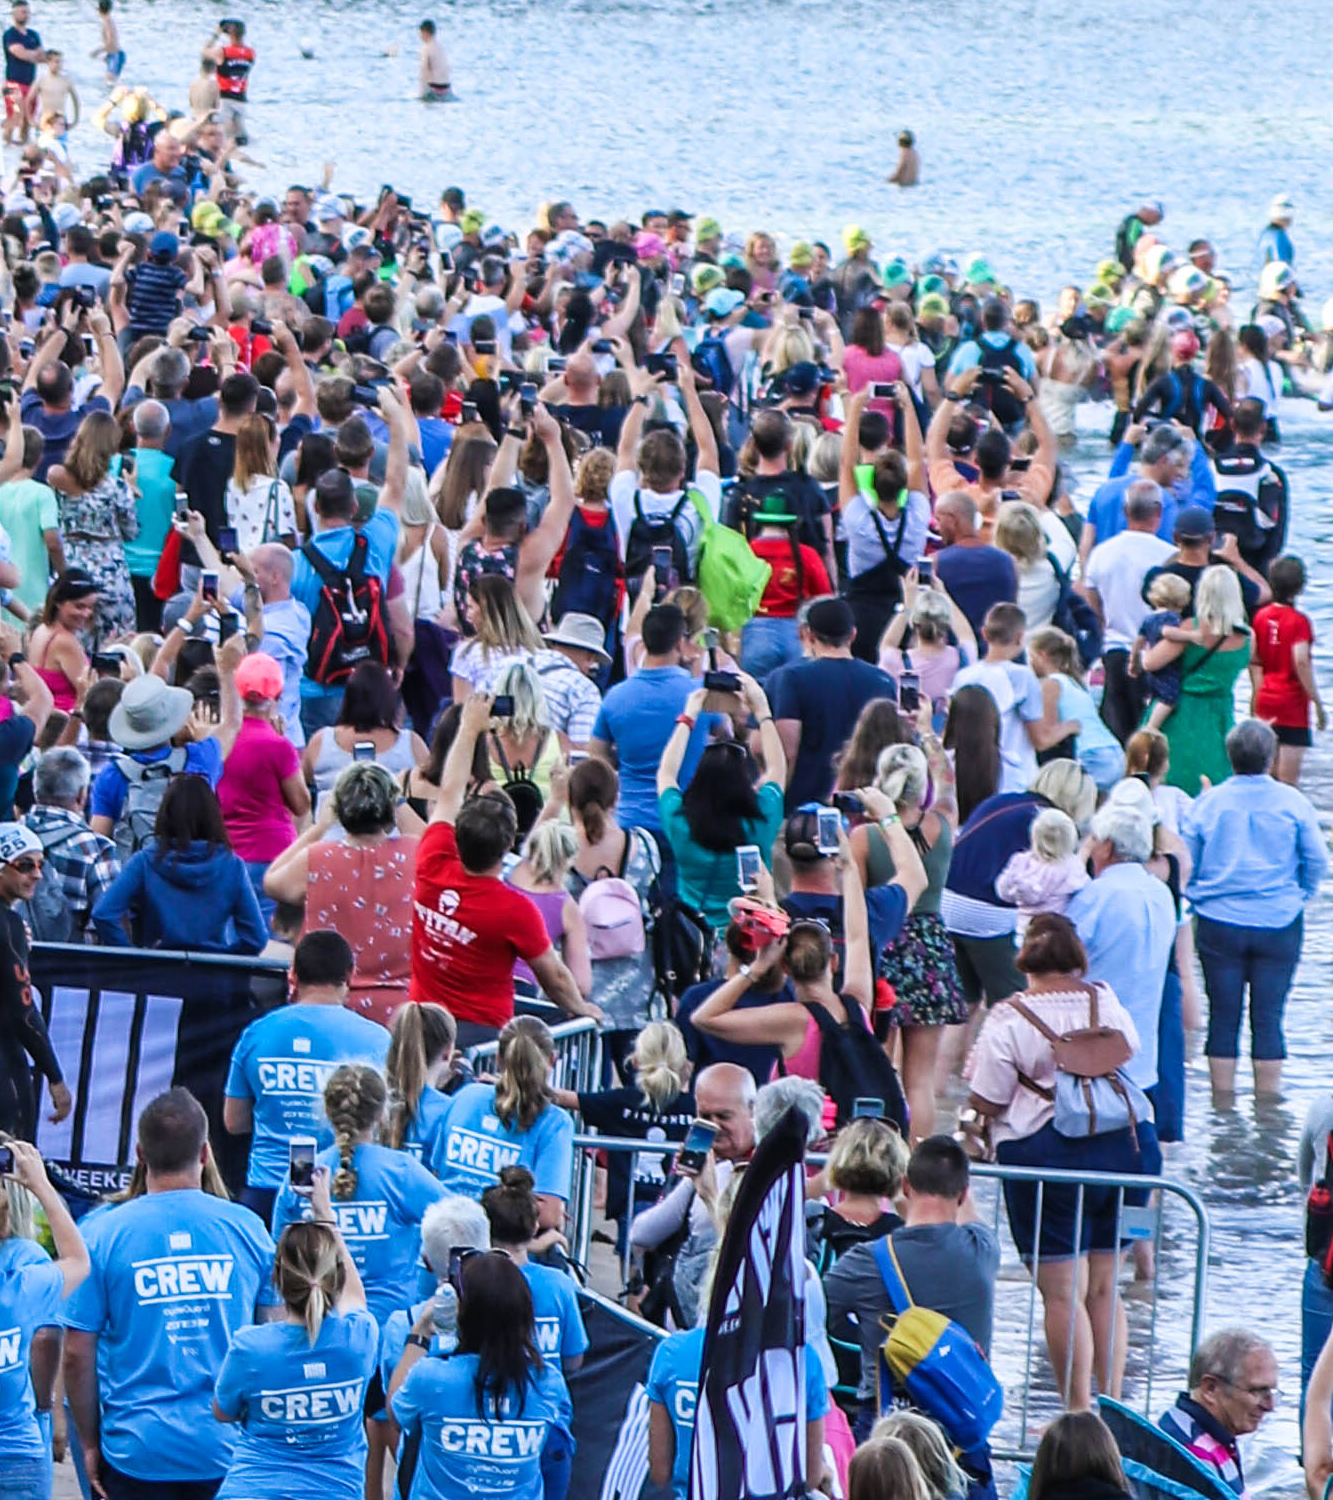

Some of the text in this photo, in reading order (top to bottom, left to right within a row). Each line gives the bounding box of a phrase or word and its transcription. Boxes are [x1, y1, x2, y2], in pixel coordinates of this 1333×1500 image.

[446, 1132, 521, 1173] CREW
[134, 1260, 234, 1298] CREW
[260, 1384, 364, 1420] CREW
[440, 1424, 547, 1457] CREW
